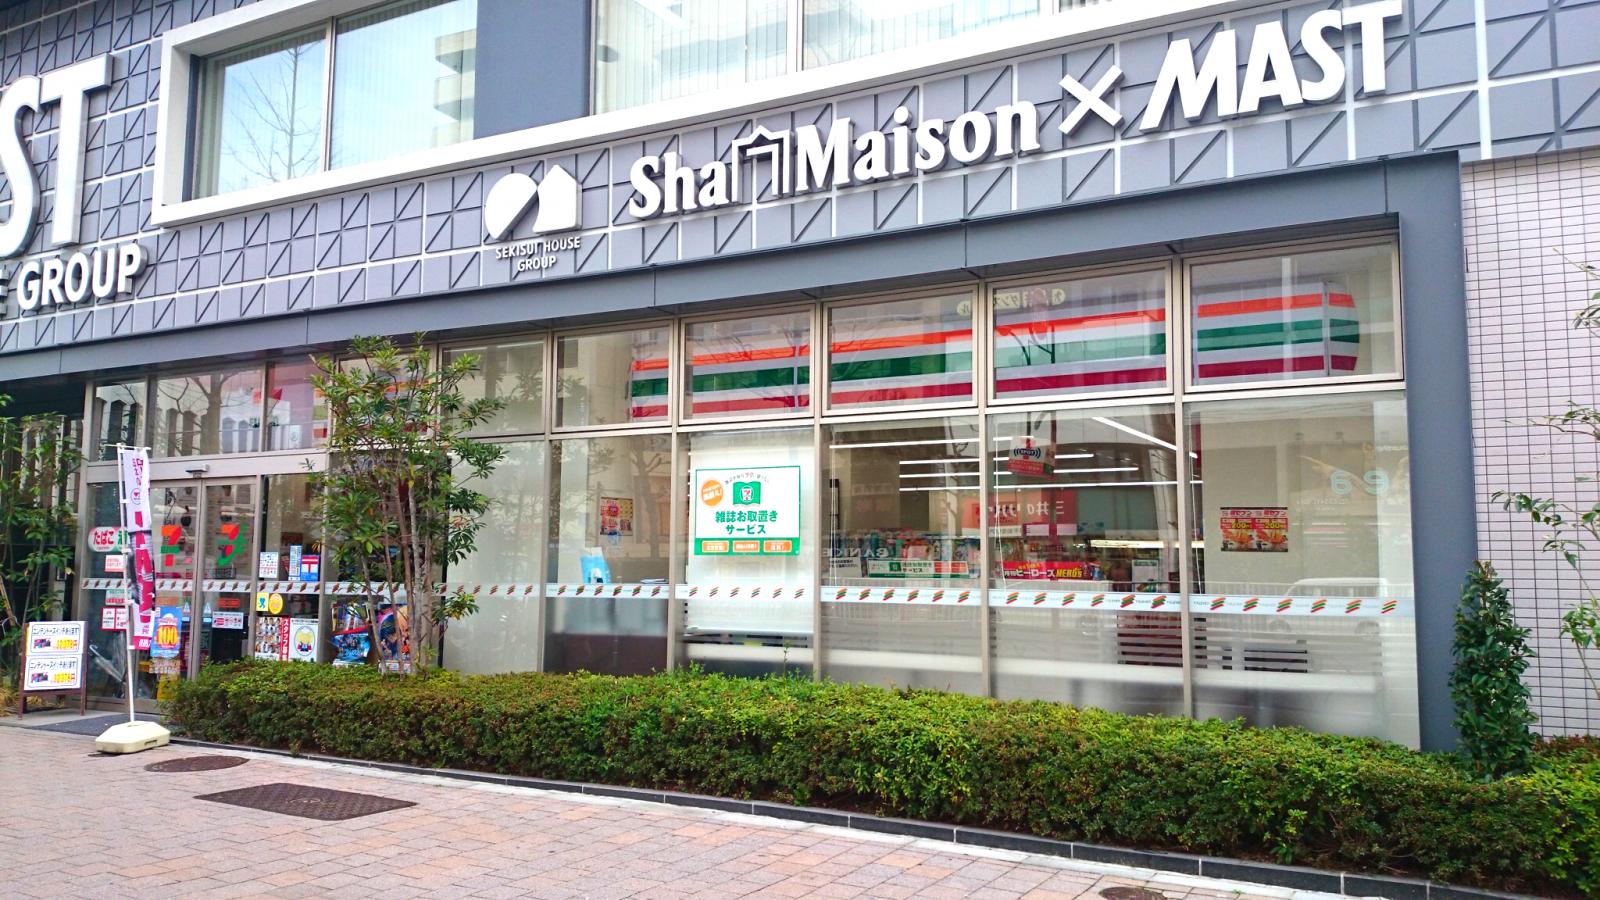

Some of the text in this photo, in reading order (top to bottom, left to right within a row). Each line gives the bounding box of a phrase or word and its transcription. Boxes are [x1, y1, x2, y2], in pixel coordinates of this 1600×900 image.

[629, 151, 731, 220] Sha
[795, 98, 1041, 193] Maison
[1139, 0, 1403, 132] MAST
[495, 236, 581, 260] SEKISUI HOUSE
[517, 255, 557, 272] GROUP
[17, 243, 148, 310] GROUP
[715, 510, 778, 523] 雑誌お取置き
[93, 529, 115, 546] たばこ
[725, 524, 766, 535] サービス
